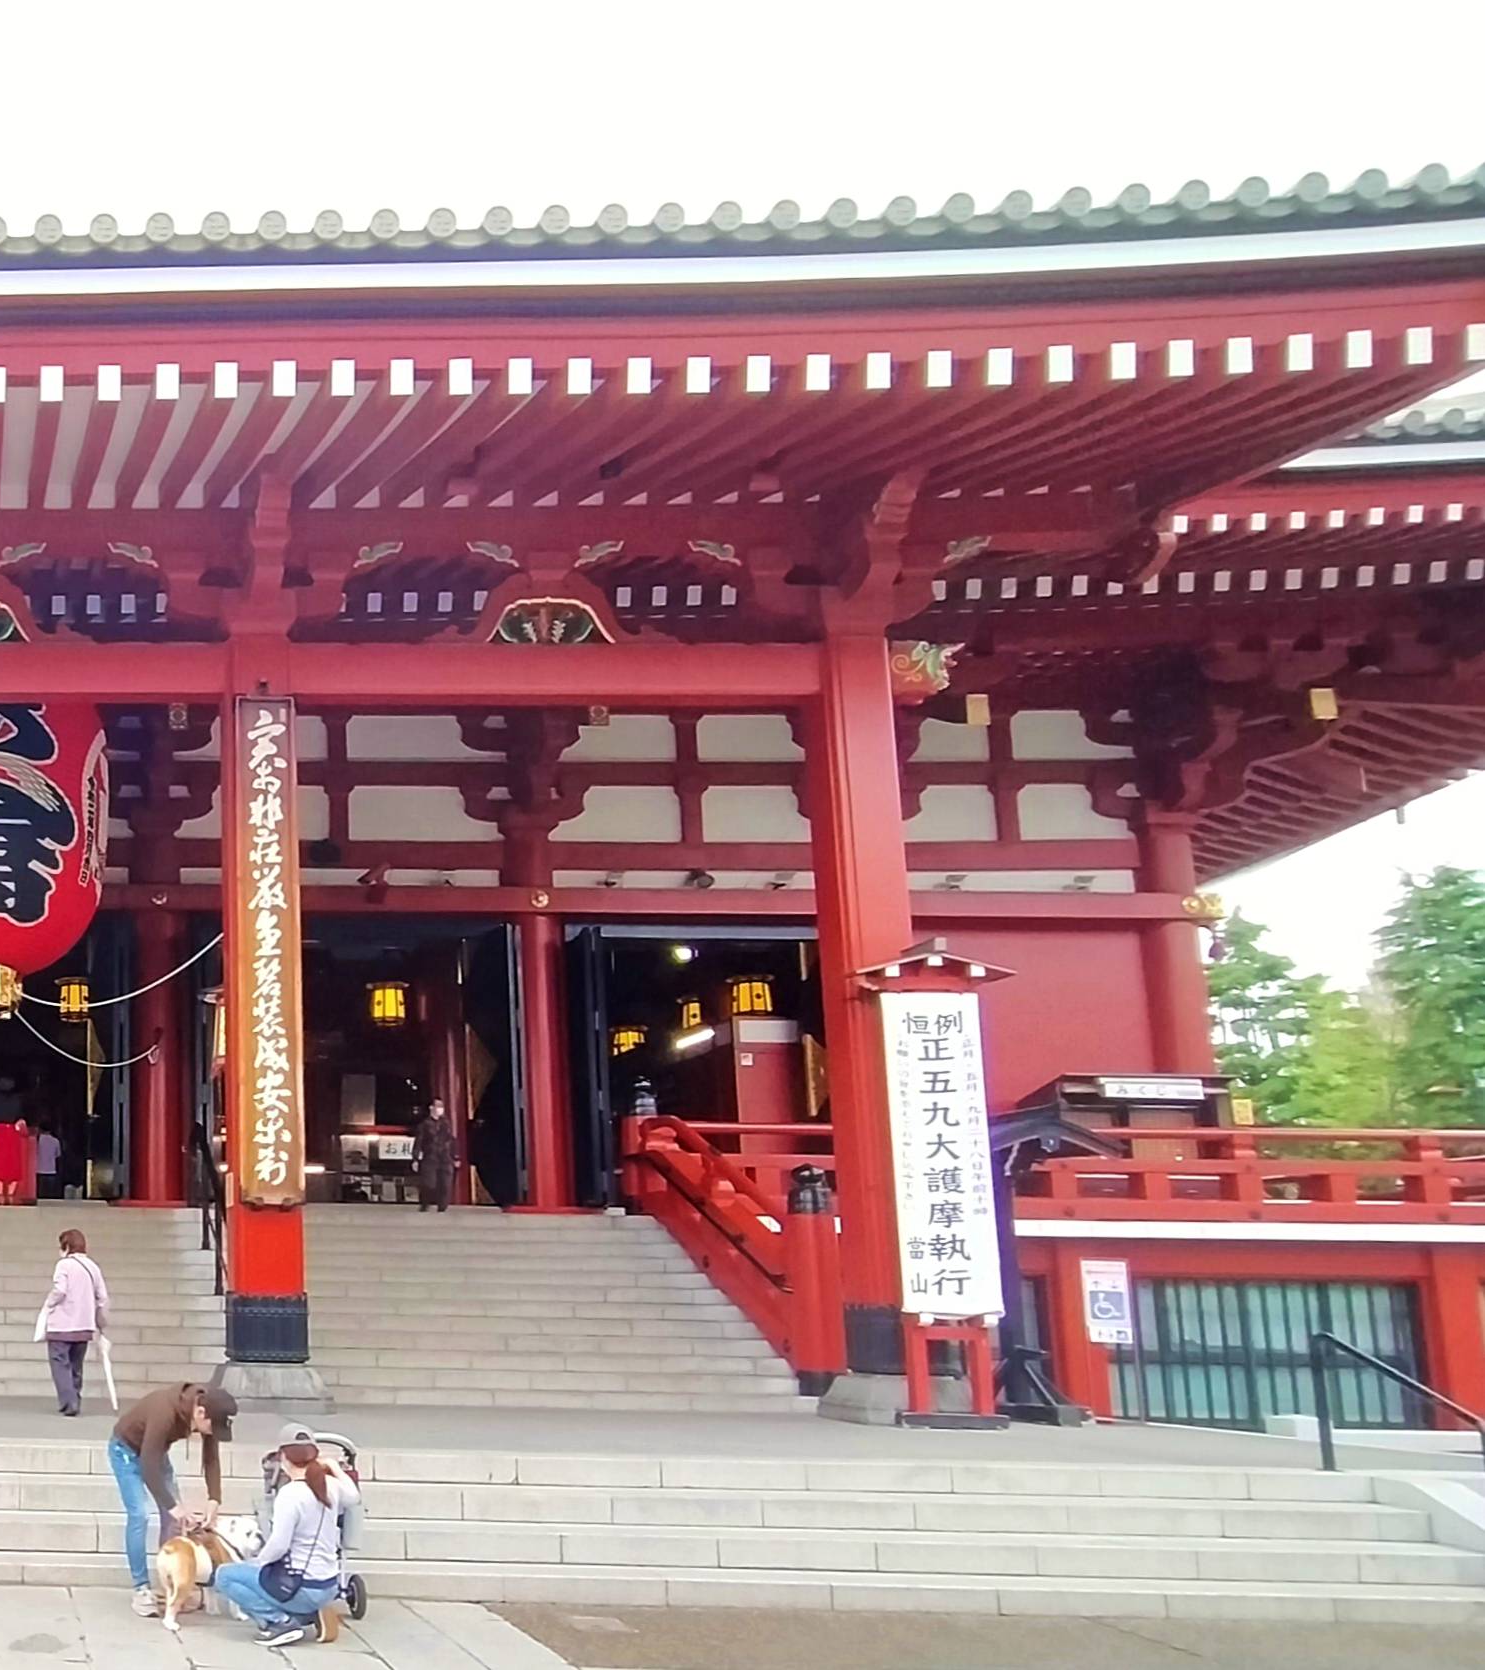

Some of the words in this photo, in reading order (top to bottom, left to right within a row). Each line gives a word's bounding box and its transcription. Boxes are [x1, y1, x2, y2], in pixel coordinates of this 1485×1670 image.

[902, 1010, 963, 1036] 恒例
[917, 1037, 972, 1296] 正五九大護摩執行
